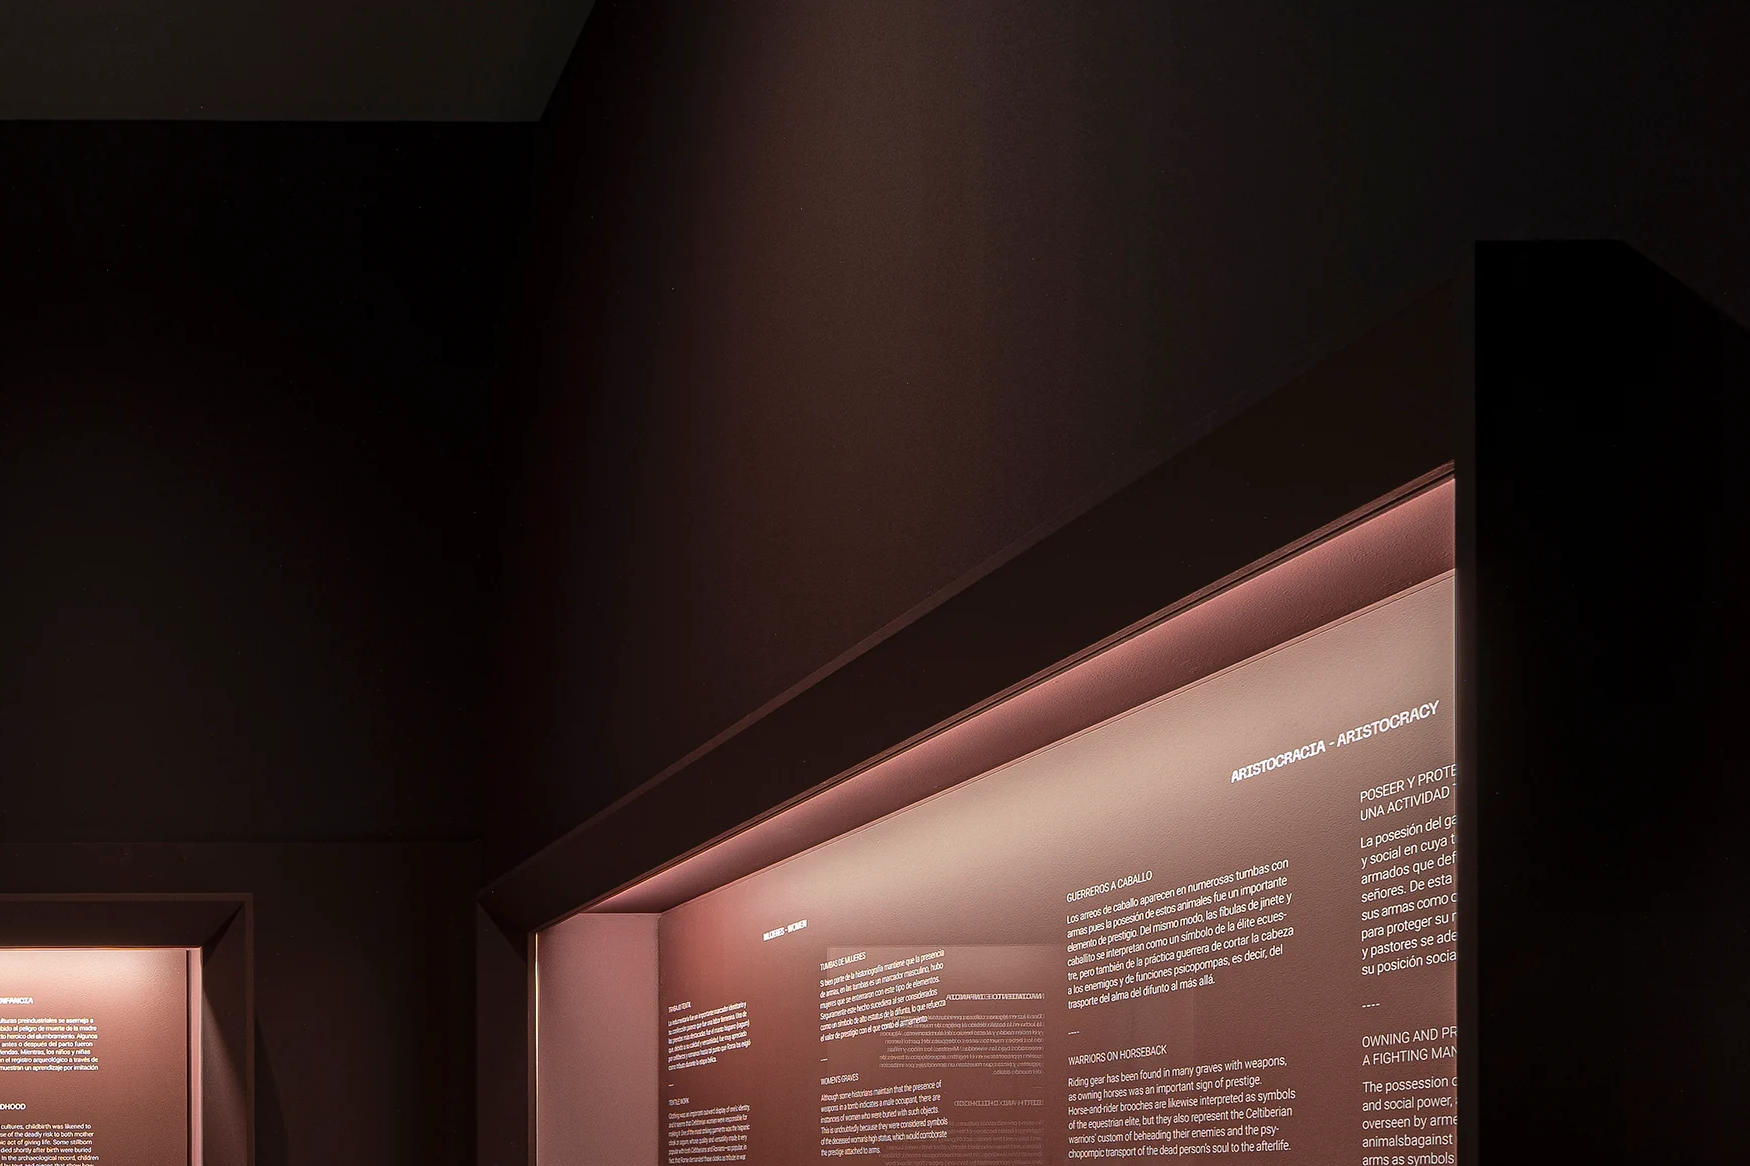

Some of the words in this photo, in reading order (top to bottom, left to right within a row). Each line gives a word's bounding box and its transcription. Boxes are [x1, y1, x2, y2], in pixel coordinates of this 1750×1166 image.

[1230, 740, 1326, 783] ARISTOCRACIA
[1337, 700, 1438, 746] ARISTOCRACY
[1360, 779, 1404, 803] POSEER
[1407, 775, 1415, 788] Y
[1360, 804, 1384, 821] UNA
[1387, 785, 1449, 813] ACTIVIDAD
[1360, 835, 1373, 849] La
[1375, 821, 1422, 849] posesión
[1425, 815, 1441, 832] del
[1361, 856, 1367, 870] y
[1369, 844, 1400, 865] social
[1403, 844, 1417, 856] en
[1420, 836, 1447, 853] cuya
[1361, 864, 1409, 885] armados
[1412, 858, 1434, 877] que
[1066, 882, 1110, 902] GUERREROS
[1110, 880, 1117, 890] A
[1116, 870, 1152, 888] CABALLO
[1066, 913, 1079, 924] Los
[1079, 908, 1101, 921] arreos
[1102, 904, 1112, 915] de
[1112, 897, 1139, 912] caballo
[1139, 889, 1175, 907] aparecen
[1176, 886, 1186, 896] en
[1187, 873, 1234, 893] numerosas
[1235, 863, 1269, 880] tumbas
[1271, 859, 1289, 871] con
[1361, 884, 1407, 903] señores.
[1409, 878, 1424, 892] De
[1427, 871, 1452, 889] esta
[1361, 908, 1379, 921] sus
[1381, 901, 1414, 917] armas
[1416, 893, 1448, 910] como
[1361, 925, 1384, 943] para
[1386, 916, 1432, 938] proteger
[1435, 913, 1448, 925] su
[1361, 947, 1368, 961] y
[1370, 938, 1417, 960] pastores
[1420, 935, 1433, 947] se
[1361, 964, 1374, 976] su
[1377, 953, 1422, 977] posición
[1361, 1030, 1409, 1047] OWNING
[1412, 1028, 1438, 1043] AND
[1067, 1052, 1106, 1066] WARRIORS
[1106, 1050, 1118, 1061] ON
[1119, 1044, 1167, 1059] HORSEBACK
[1362, 1052, 1370, 1066] A
[1373, 1047, 1427, 1065] FIGHTING
[1067, 1076, 1089, 1088] Riding
[1089, 1076, 1105, 1087] gear
[1106, 1072, 1119, 1083] has
[1120, 1071, 1138, 1081] been
[1139, 1067, 1161, 1079] found
[1162, 1066, 1170, 1077] in
[1171, 1067, 1194, 1078] many
[1195, 1064, 1222, 1077] graves
[1224, 1058, 1242, 1071] with
[1244, 1057, 1288, 1070] weapons,
[1364, 1079, 1382, 1093] The
[1385, 1075, 1448, 1095] possession
[1068, 1093, 1076, 1101] as
[1077, 1089, 1102, 1102] owning
[1103, 1088, 1127, 1098] horses
[1128, 1087, 1144, 1096] was
[1144, 1086, 1155, 1094] an
[1155, 1080, 1194, 1095] important
[1195, 1079, 1213, 1092] sign
[1214, 1077, 1223, 1088] of
[1225, 1074, 1261, 1090] prestige.
[1362, 1097, 1381, 1111] and
[1383, 1095, 1414, 1110] social
[1417, 1097, 1453, 1112] power,
[1362, 1118, 1410, 1129] overseen
[1413, 1114, 1427, 1130] by
[1362, 1132, 1453, 1149] animalsbagainst
[1362, 1156, 1389, 1165] arms
[1391, 1155, 1404, 1165] as
